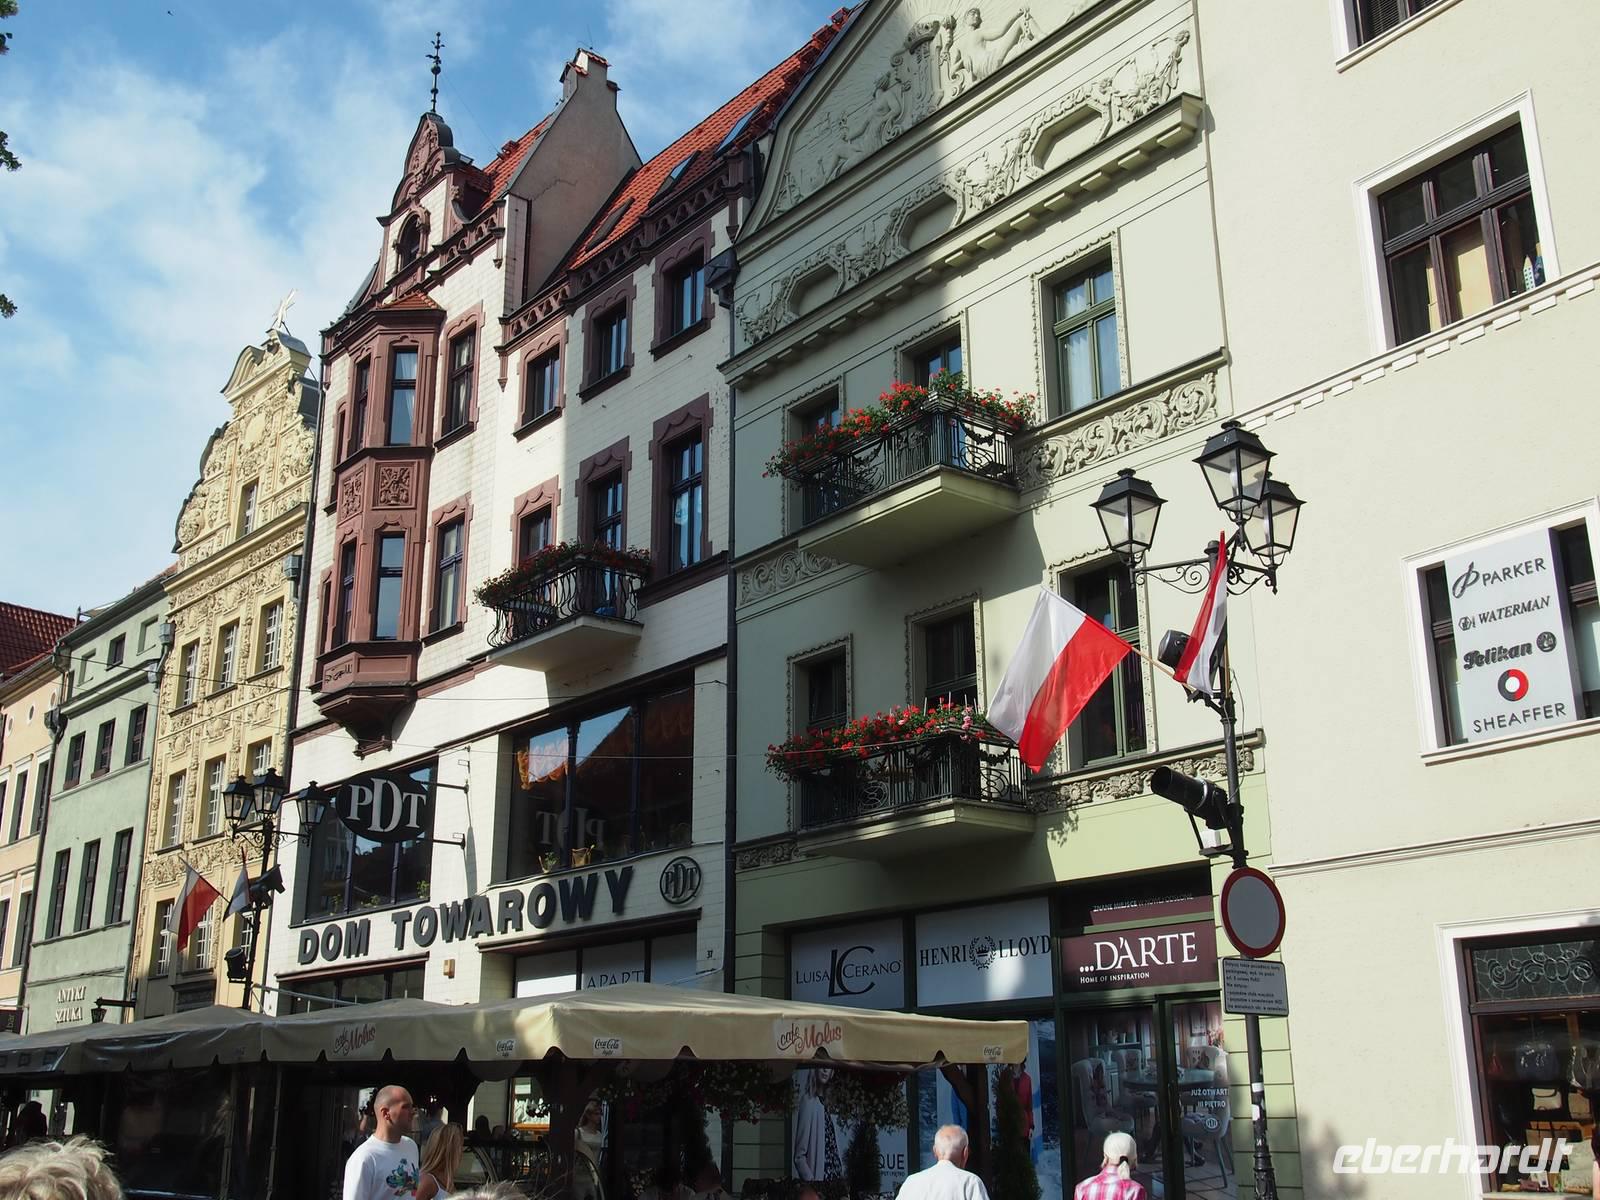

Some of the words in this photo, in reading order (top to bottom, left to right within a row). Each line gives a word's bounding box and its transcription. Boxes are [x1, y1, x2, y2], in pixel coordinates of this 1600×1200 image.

[1483, 557, 1546, 587] PARKER
[1479, 596, 1550, 625] WATERMAN
[1463, 640, 1533, 670] Pelikan
[1473, 702, 1566, 734] SHEAFFER
[348, 777, 428, 834] PDT
[664, 863, 698, 899] PDT
[297, 918, 371, 965] DOM
[391, 865, 634, 950] TOWAROWY
[920, 943, 967, 967] HENRI
[998, 934, 1051, 959] LLOYD
[587, 969, 644, 989] APART
[795, 969, 830, 985] LUISA
[828, 945, 876, 998] LC
[842, 960, 900, 979] CERANO
